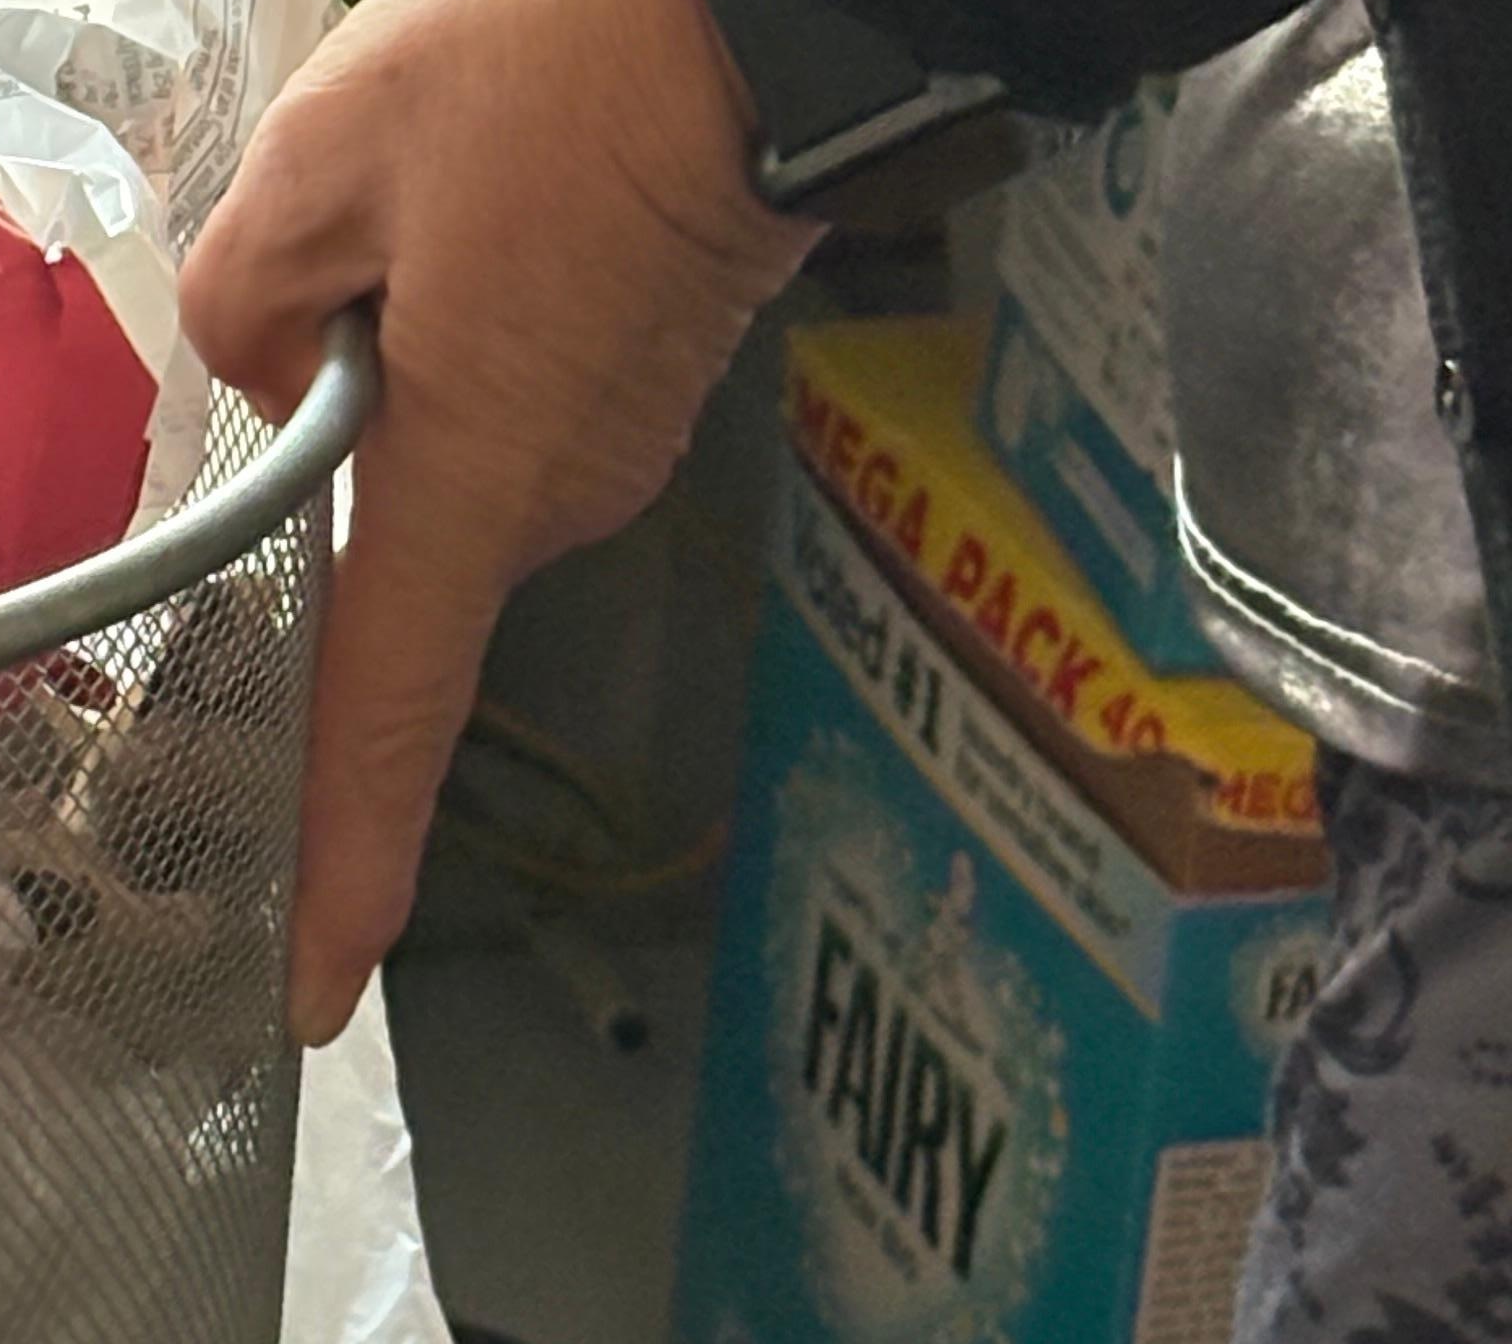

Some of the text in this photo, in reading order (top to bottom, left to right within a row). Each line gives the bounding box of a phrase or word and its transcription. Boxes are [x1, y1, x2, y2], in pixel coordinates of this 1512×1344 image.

[790, 372, 930, 563] MEGA
[942, 530, 1103, 723] PACK
[1215, 769, 1324, 822] MEG
[802, 912, 1008, 1281] FAIRY
